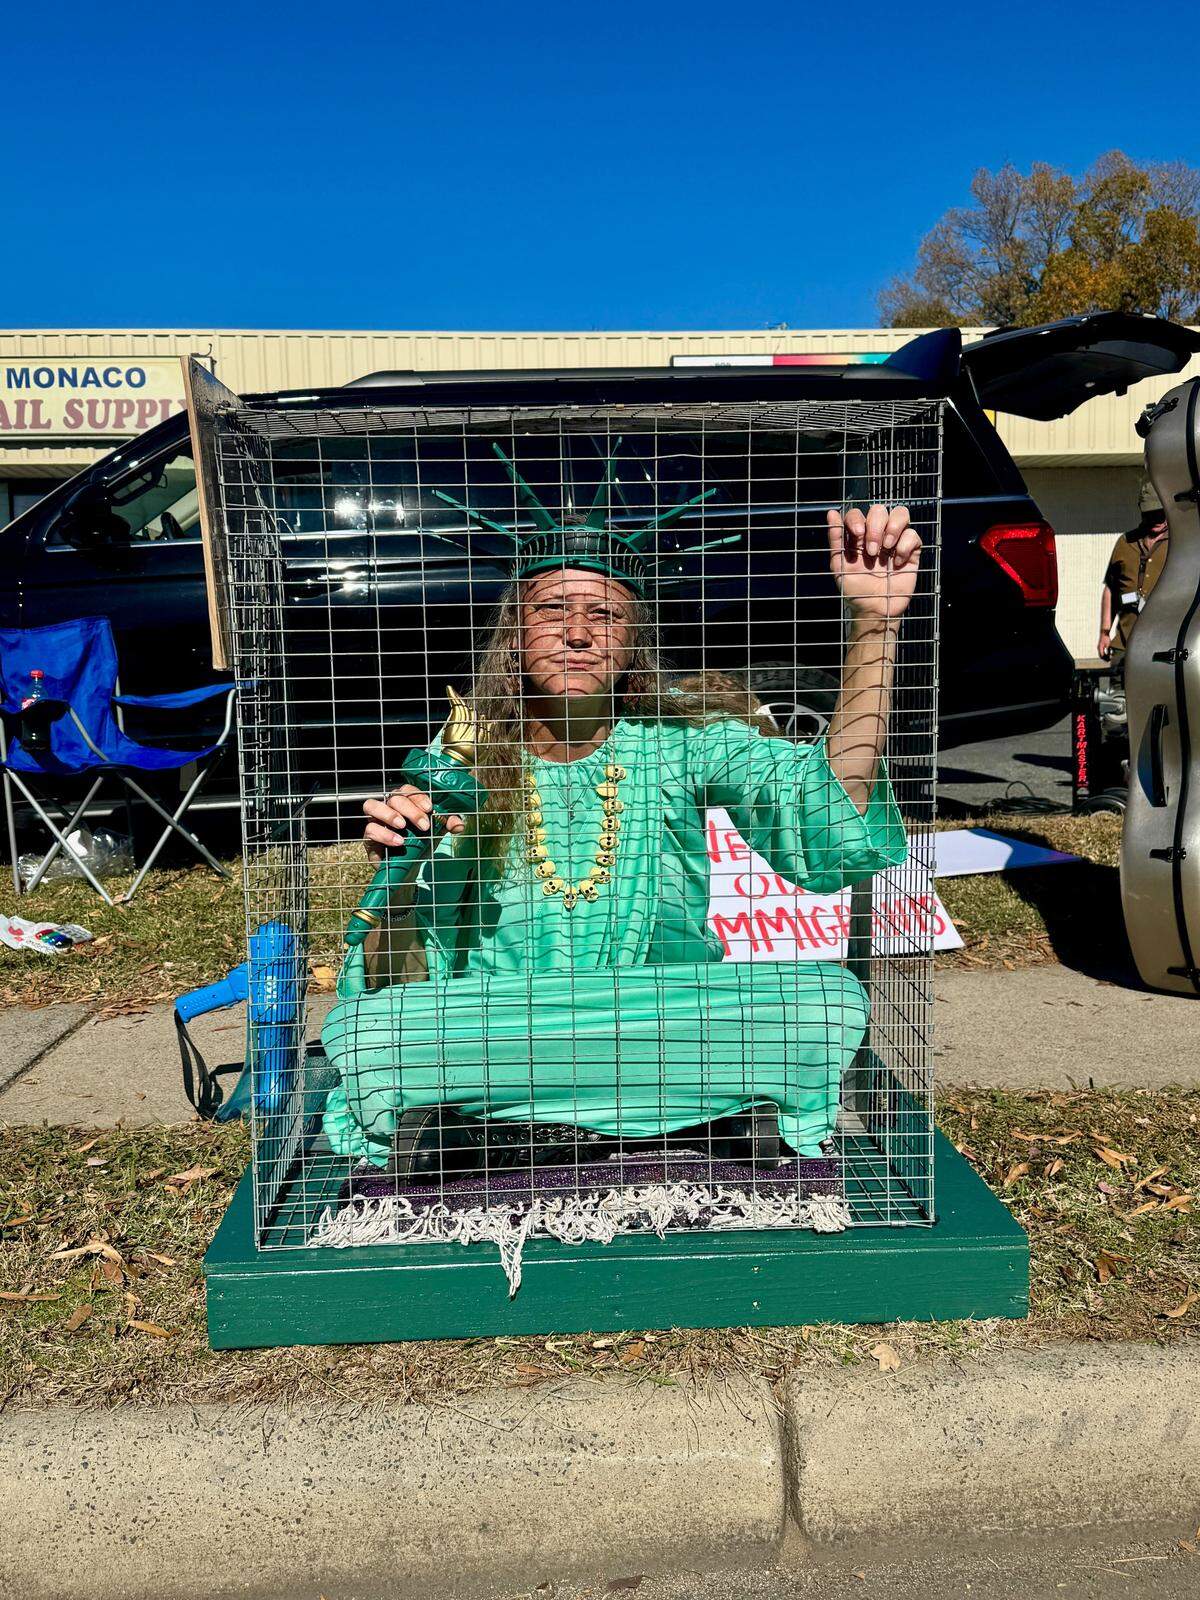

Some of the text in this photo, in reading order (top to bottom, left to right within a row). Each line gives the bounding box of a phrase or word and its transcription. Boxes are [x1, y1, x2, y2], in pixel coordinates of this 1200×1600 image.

[6, 367, 146, 389] MONACO
[1077, 714, 1088, 782] KARTMASTER
[734, 872, 806, 899] OU
